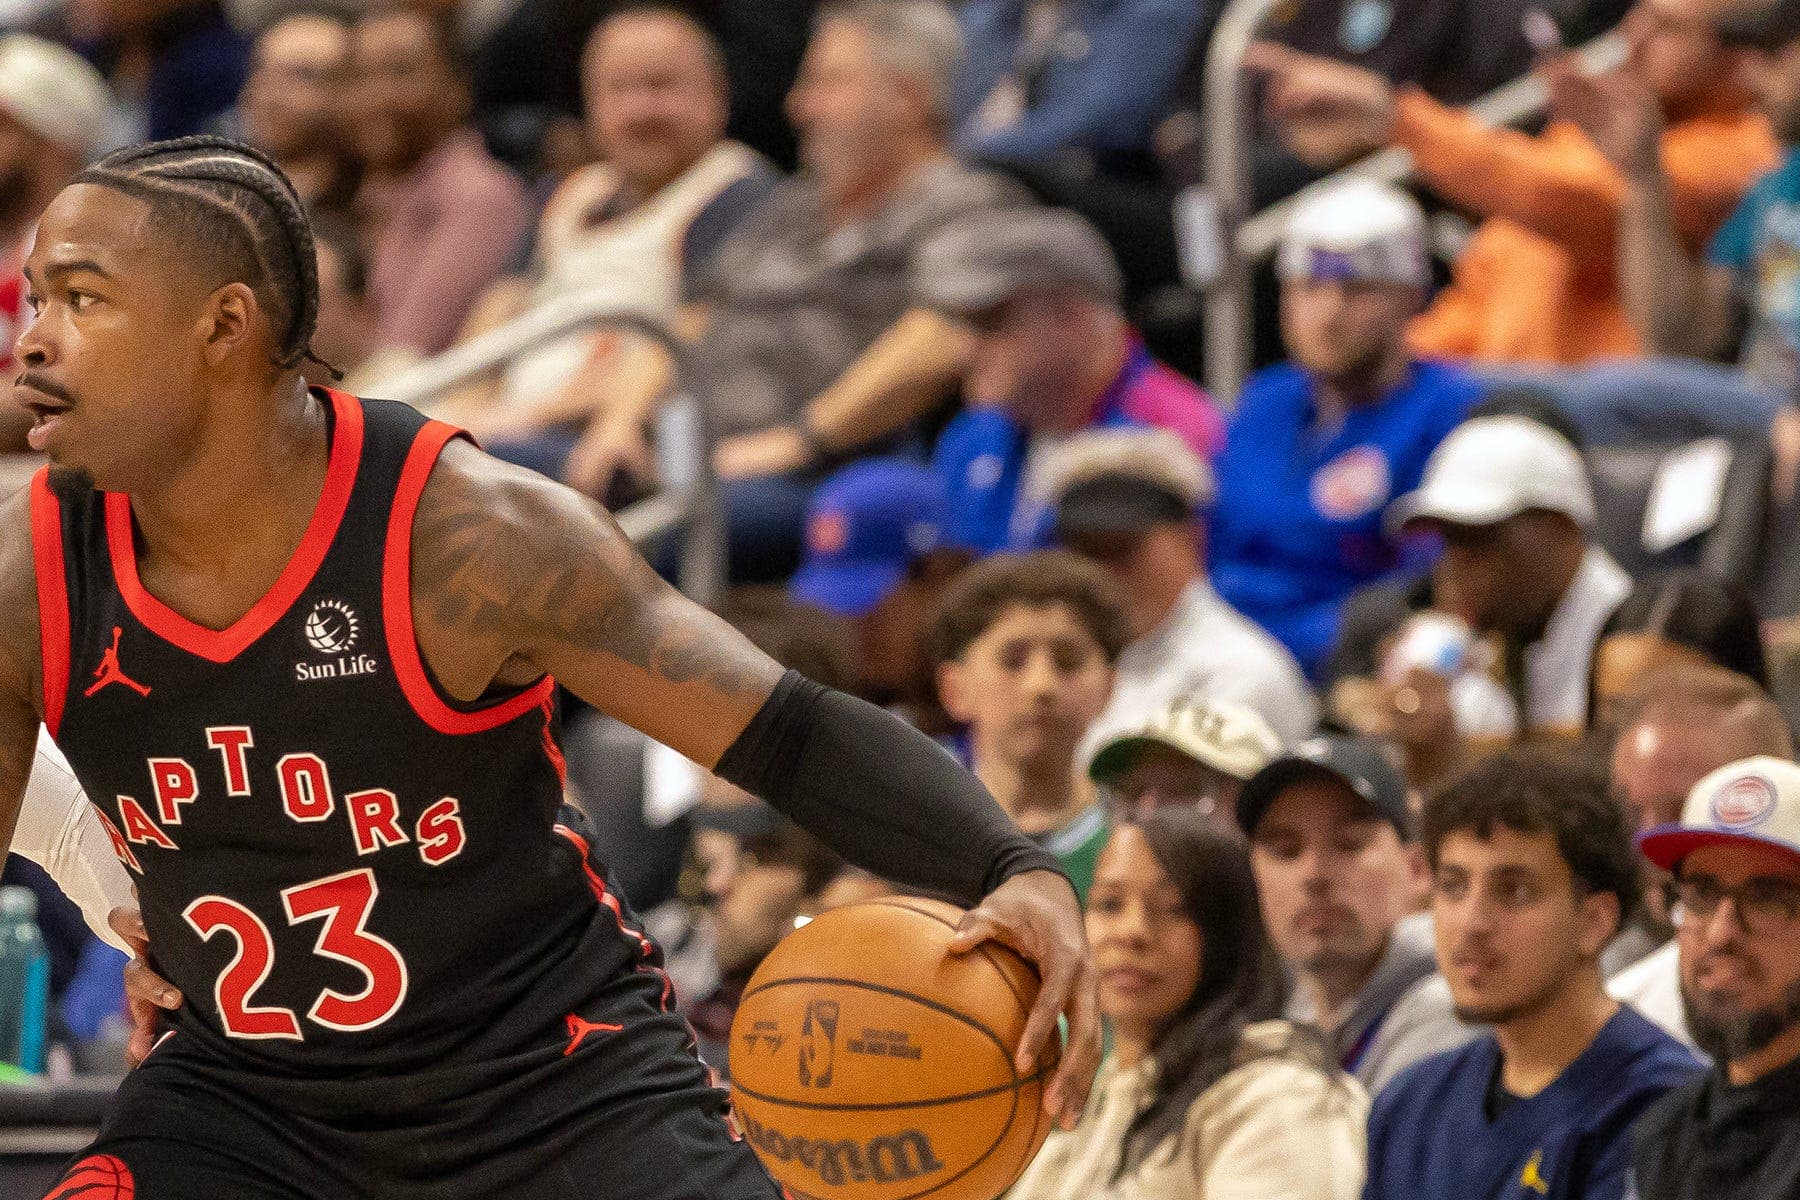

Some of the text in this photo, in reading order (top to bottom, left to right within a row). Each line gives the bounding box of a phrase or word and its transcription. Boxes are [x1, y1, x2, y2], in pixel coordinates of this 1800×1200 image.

[295, 654, 377, 680] Sun Life
[182, 868, 408, 1041] 23
[742, 1110, 945, 1187] Wilson
